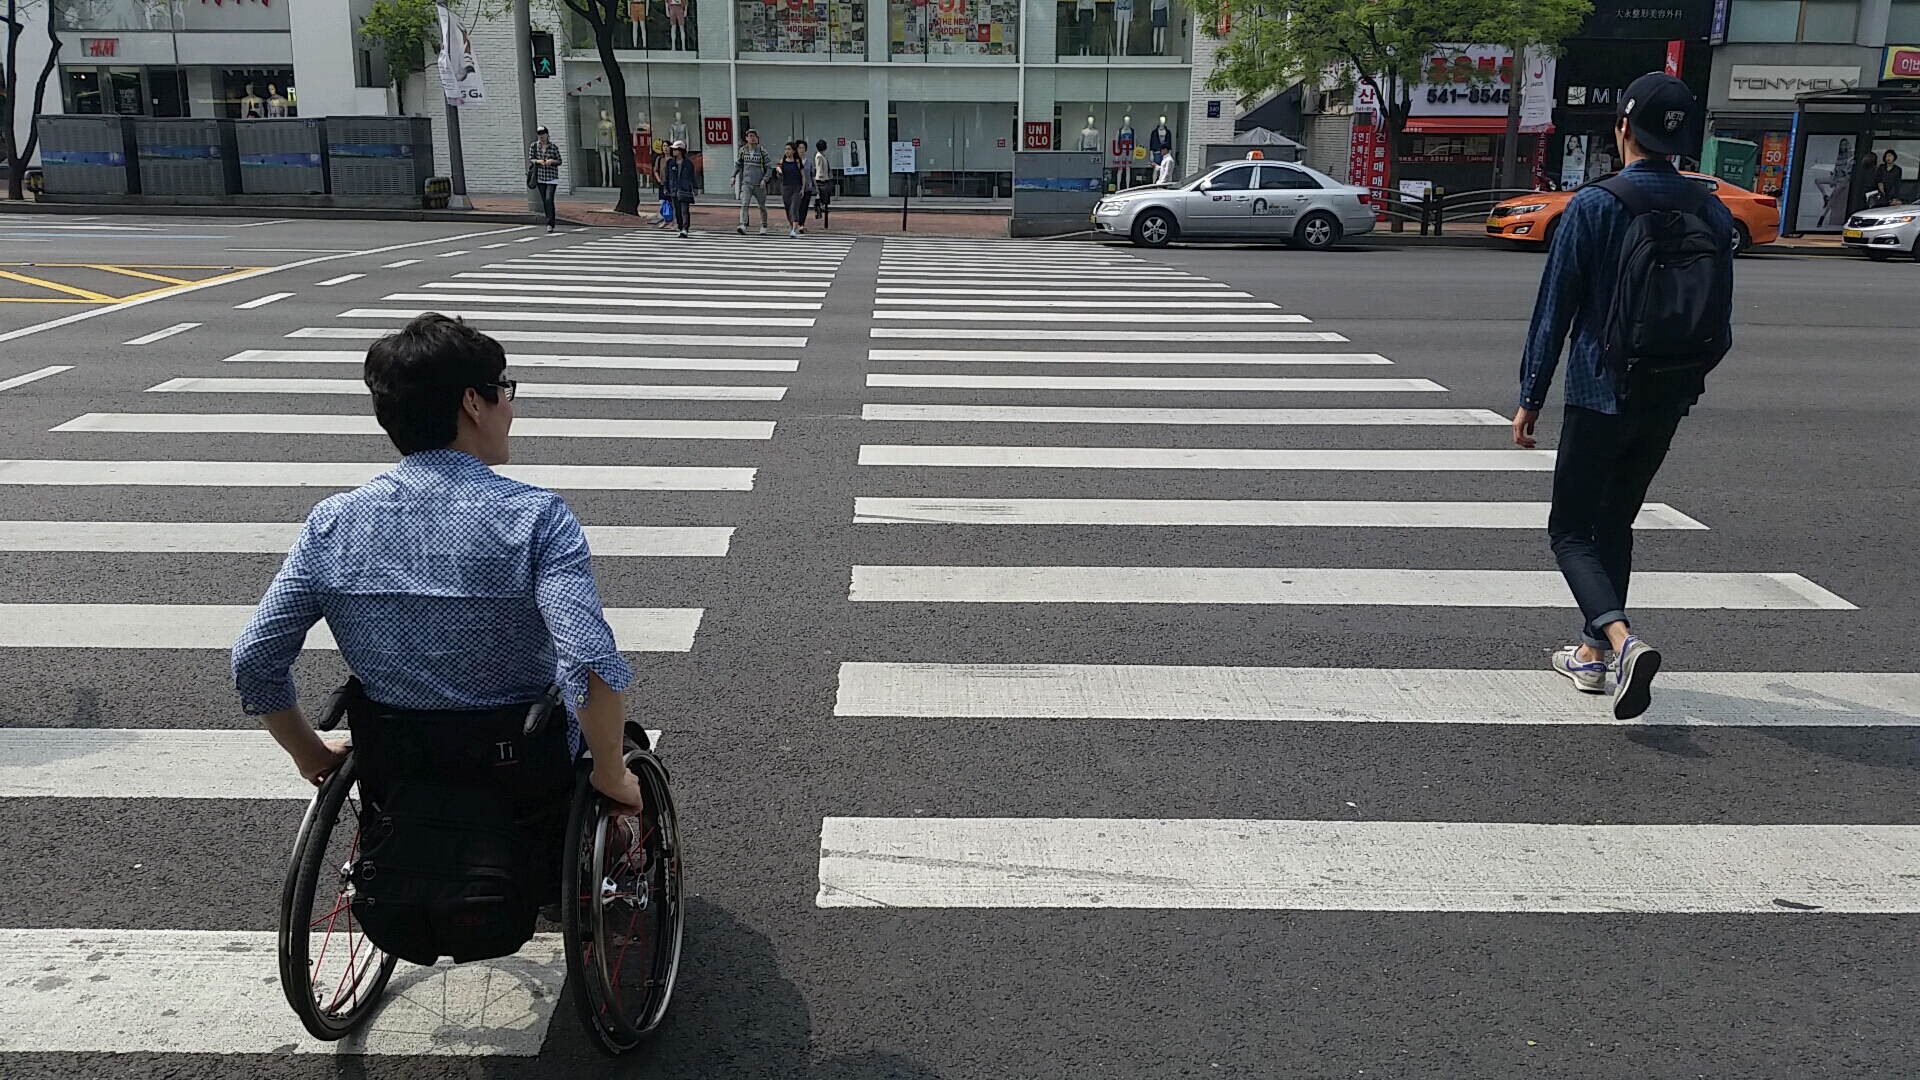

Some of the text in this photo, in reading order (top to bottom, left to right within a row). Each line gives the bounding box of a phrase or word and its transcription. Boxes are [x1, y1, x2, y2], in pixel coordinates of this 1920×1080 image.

[1615, 9, 1683, 19] 大永整形美容外科
[939, 18, 970, 26] THE NEW
[90, 39, 115, 57] H&M
[1733, 77, 1858, 90] TONYMOLY
[469, 88, 483, 98] G4
[1427, 88, 1511, 104] 541-8545
[1665, 111, 1685, 121] NETS
[707, 121, 727, 130] UNI
[1028, 125, 1047, 135] UNI
[708, 132, 729, 142] QLO
[1028, 136, 1048, 146] QLO
[1112, 140, 1133, 157] UT
[1349, 132, 1357, 185] 조은부동
[1362, 132, 1370, 186] 조은부동
[1765, 151, 1782, 163] 50
[495, 741, 513, 760] Ti
